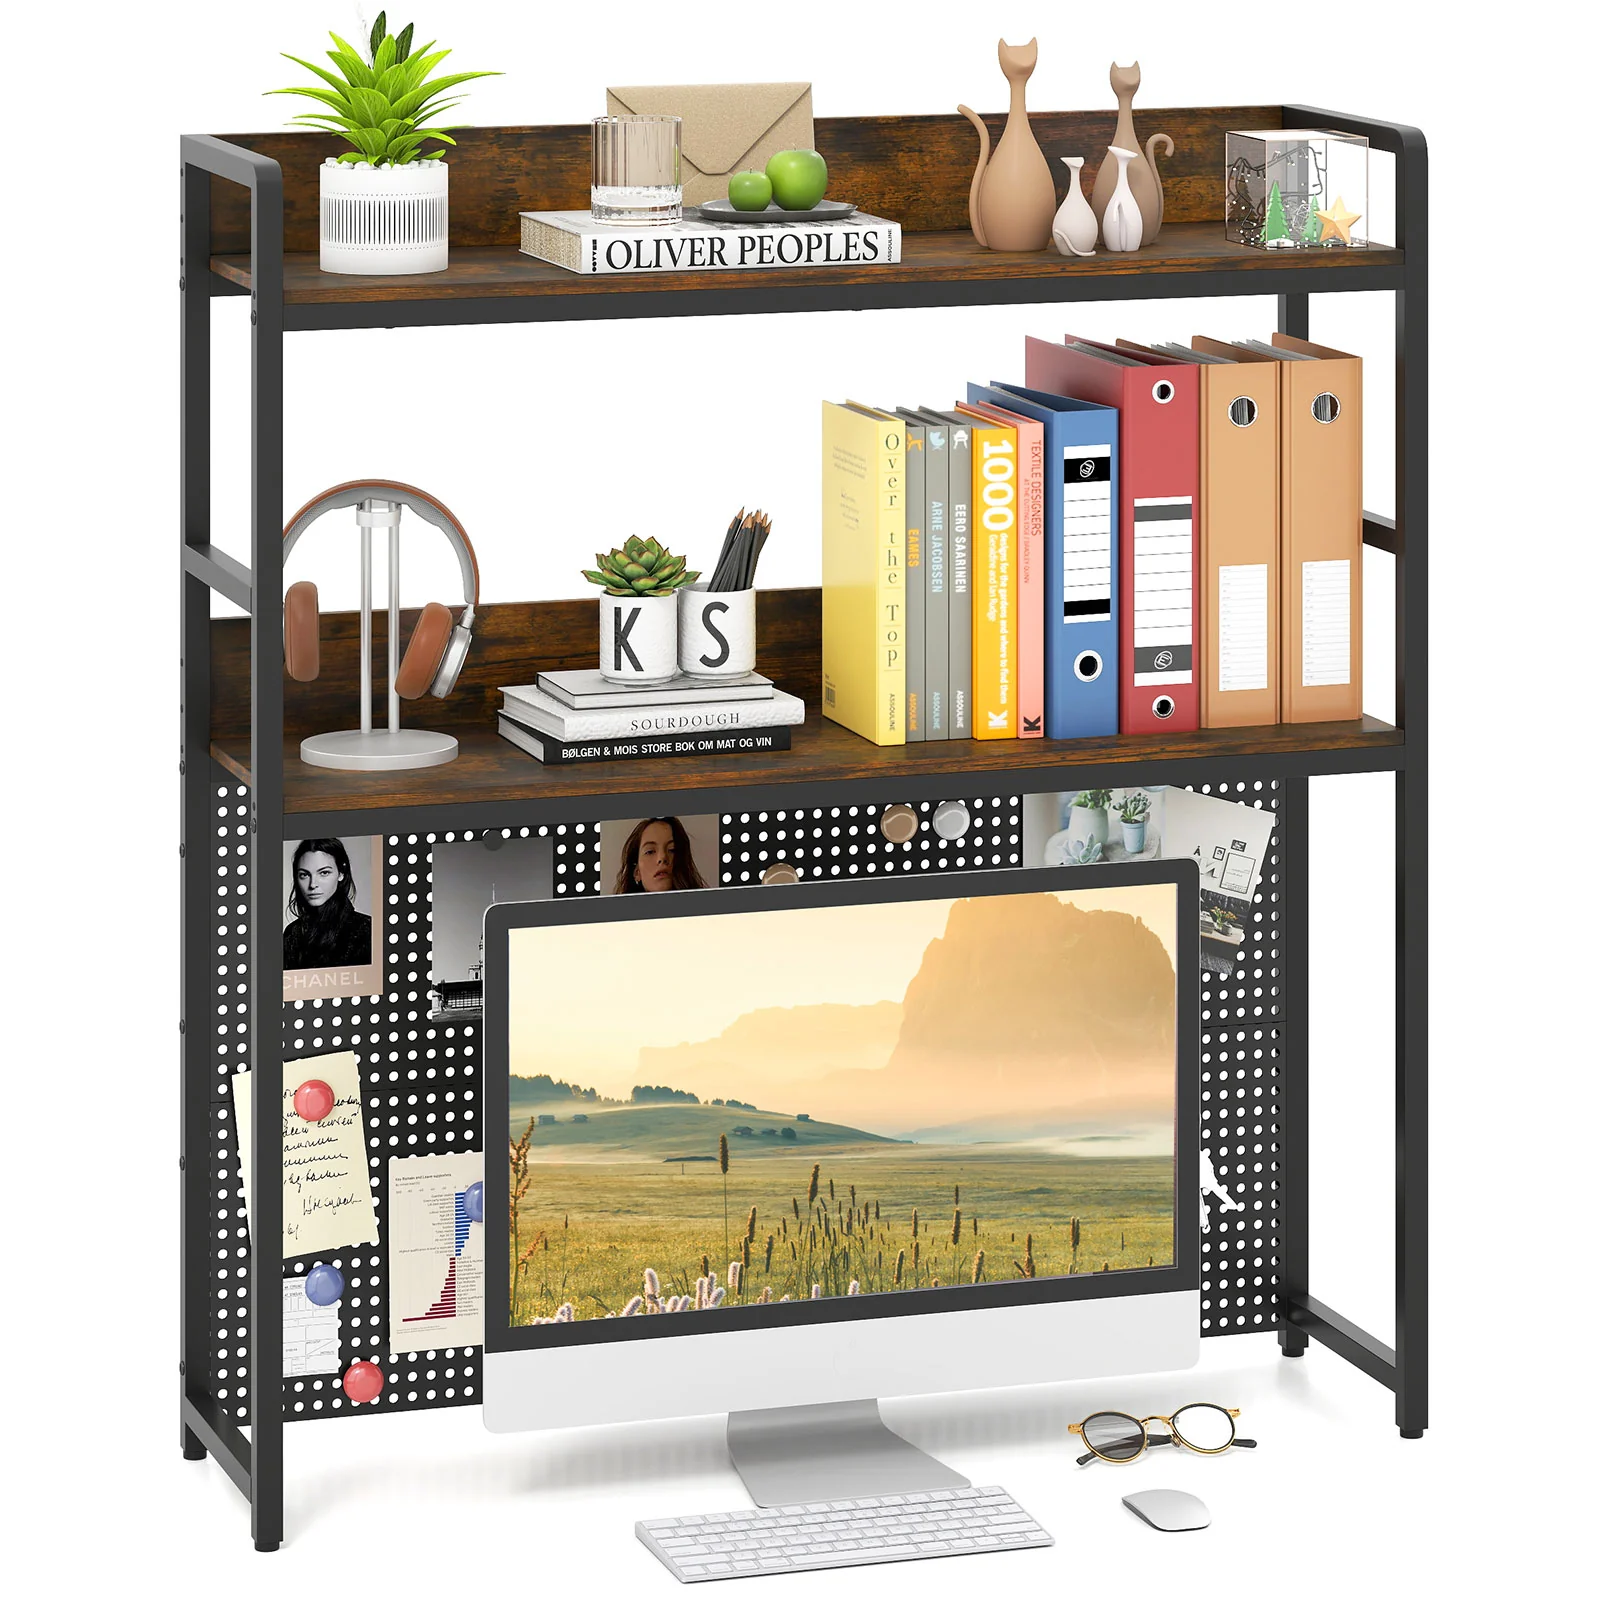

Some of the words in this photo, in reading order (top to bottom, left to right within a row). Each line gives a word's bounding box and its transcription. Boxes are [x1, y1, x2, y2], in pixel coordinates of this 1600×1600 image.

[605, 236, 728, 271] OLIVER
[738, 231, 879, 265] PEOPLES
[885, 433, 899, 506] Over
[1031, 440, 1042, 478] TEXTILE
[982, 440, 1014, 531] 1000
[931, 501, 943, 531] ARNE
[955, 504, 966, 533] EERO
[1031, 481, 1042, 536] DESIGNERS
[887, 532, 898, 583] the
[908, 528, 920, 567] EAMES
[931, 534, 943, 593] JACOBSEN
[955, 536, 966, 593] SAARINEN
[614, 606, 644, 671] K
[699, 601, 730, 668] S
[630, 712, 740, 732] SOURDOUGH
[909, 693, 917, 731] ASSOULINE
[933, 692, 941, 730] ASSOULINE
[956, 690, 964, 729] ASSOULINE
[562, 746, 601, 759] BØLGEN
[603, 746, 611, 756] &
[613, 745, 638, 756] MOIS
[641, 742, 672, 754] STORE
[675, 741, 695, 752] BOK
[698, 739, 714, 750] OM
[716, 738, 737, 749] MAT
[739, 737, 754, 748] OG
[756, 736, 772, 747] VIN
[283, 971, 364, 990] CHANEL
